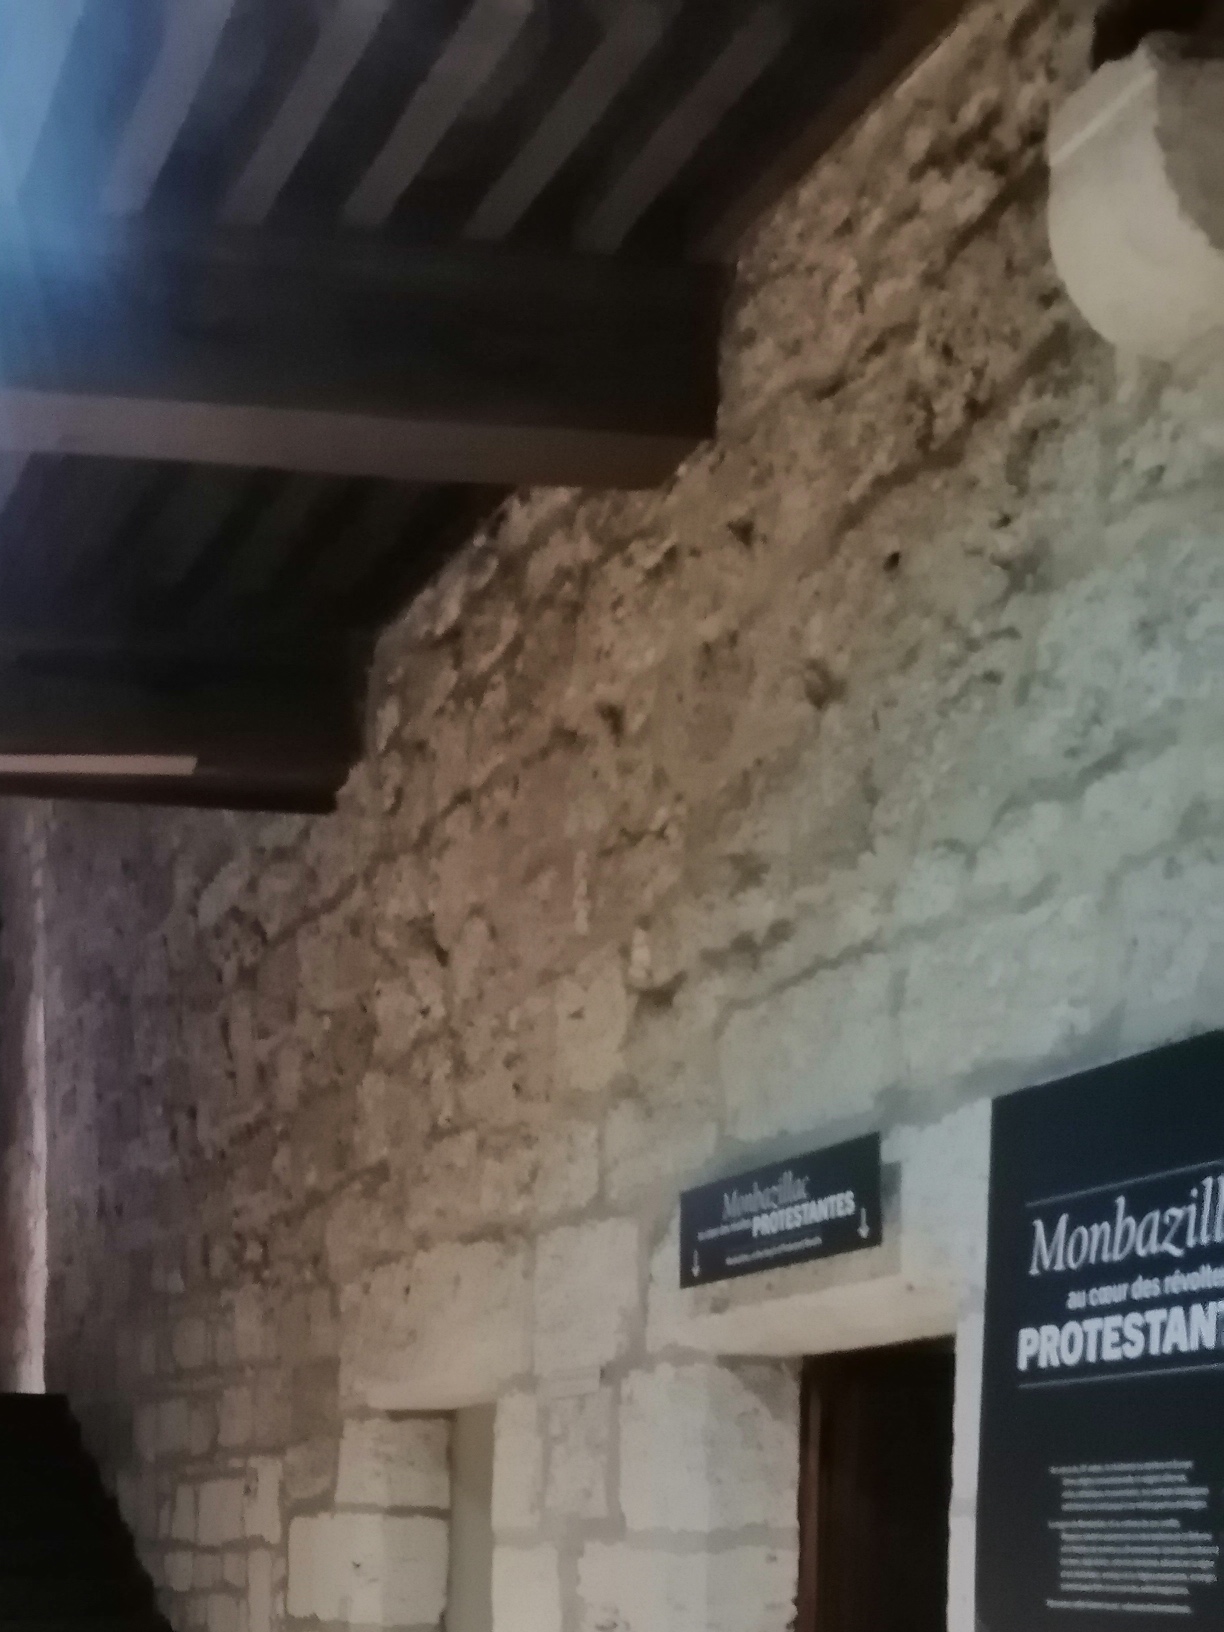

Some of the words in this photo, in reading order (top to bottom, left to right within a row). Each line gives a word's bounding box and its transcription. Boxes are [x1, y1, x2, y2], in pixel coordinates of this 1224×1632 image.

[751, 1190, 855, 1238] PROTESTANTES
[1066, 1289, 1086, 1310] au
[1131, 1274, 1161, 1300] des
